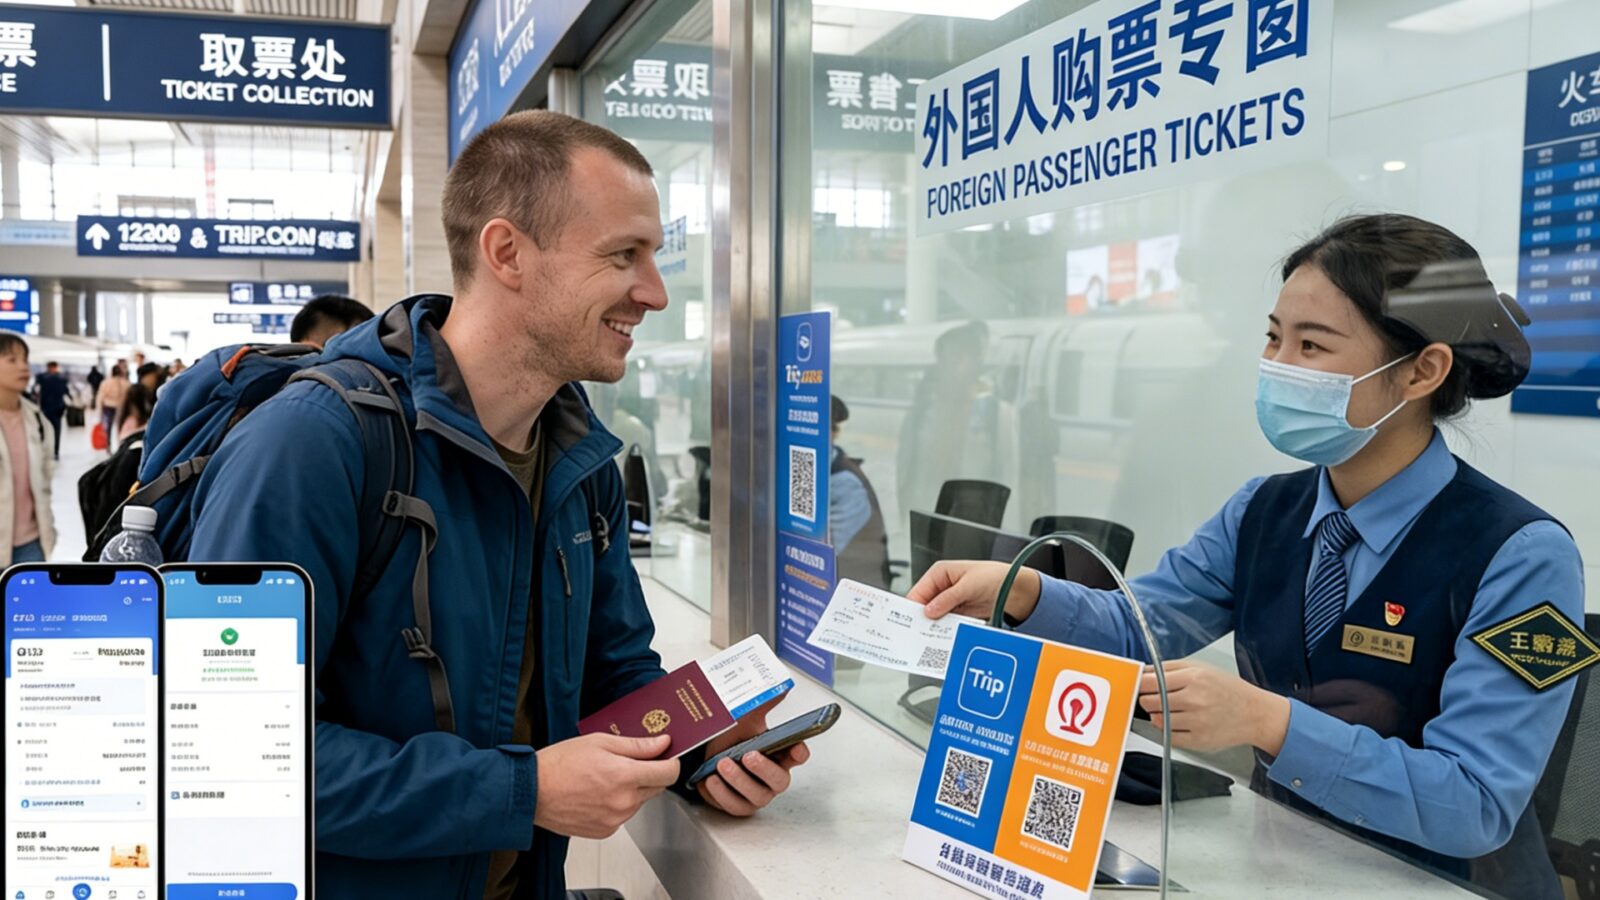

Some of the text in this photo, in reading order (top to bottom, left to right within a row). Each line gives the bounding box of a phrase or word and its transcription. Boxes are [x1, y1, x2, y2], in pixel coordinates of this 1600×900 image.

[200, 33, 347, 82] 取票处
[0, 72, 17, 92] E
[160, 79, 375, 107] TICKET COLLECTION
[926, 87, 1306, 219] FOREIGN PASSENGER TICKETS
[189, 227, 208, 248] &
[968, 667, 1005, 698] Trip
